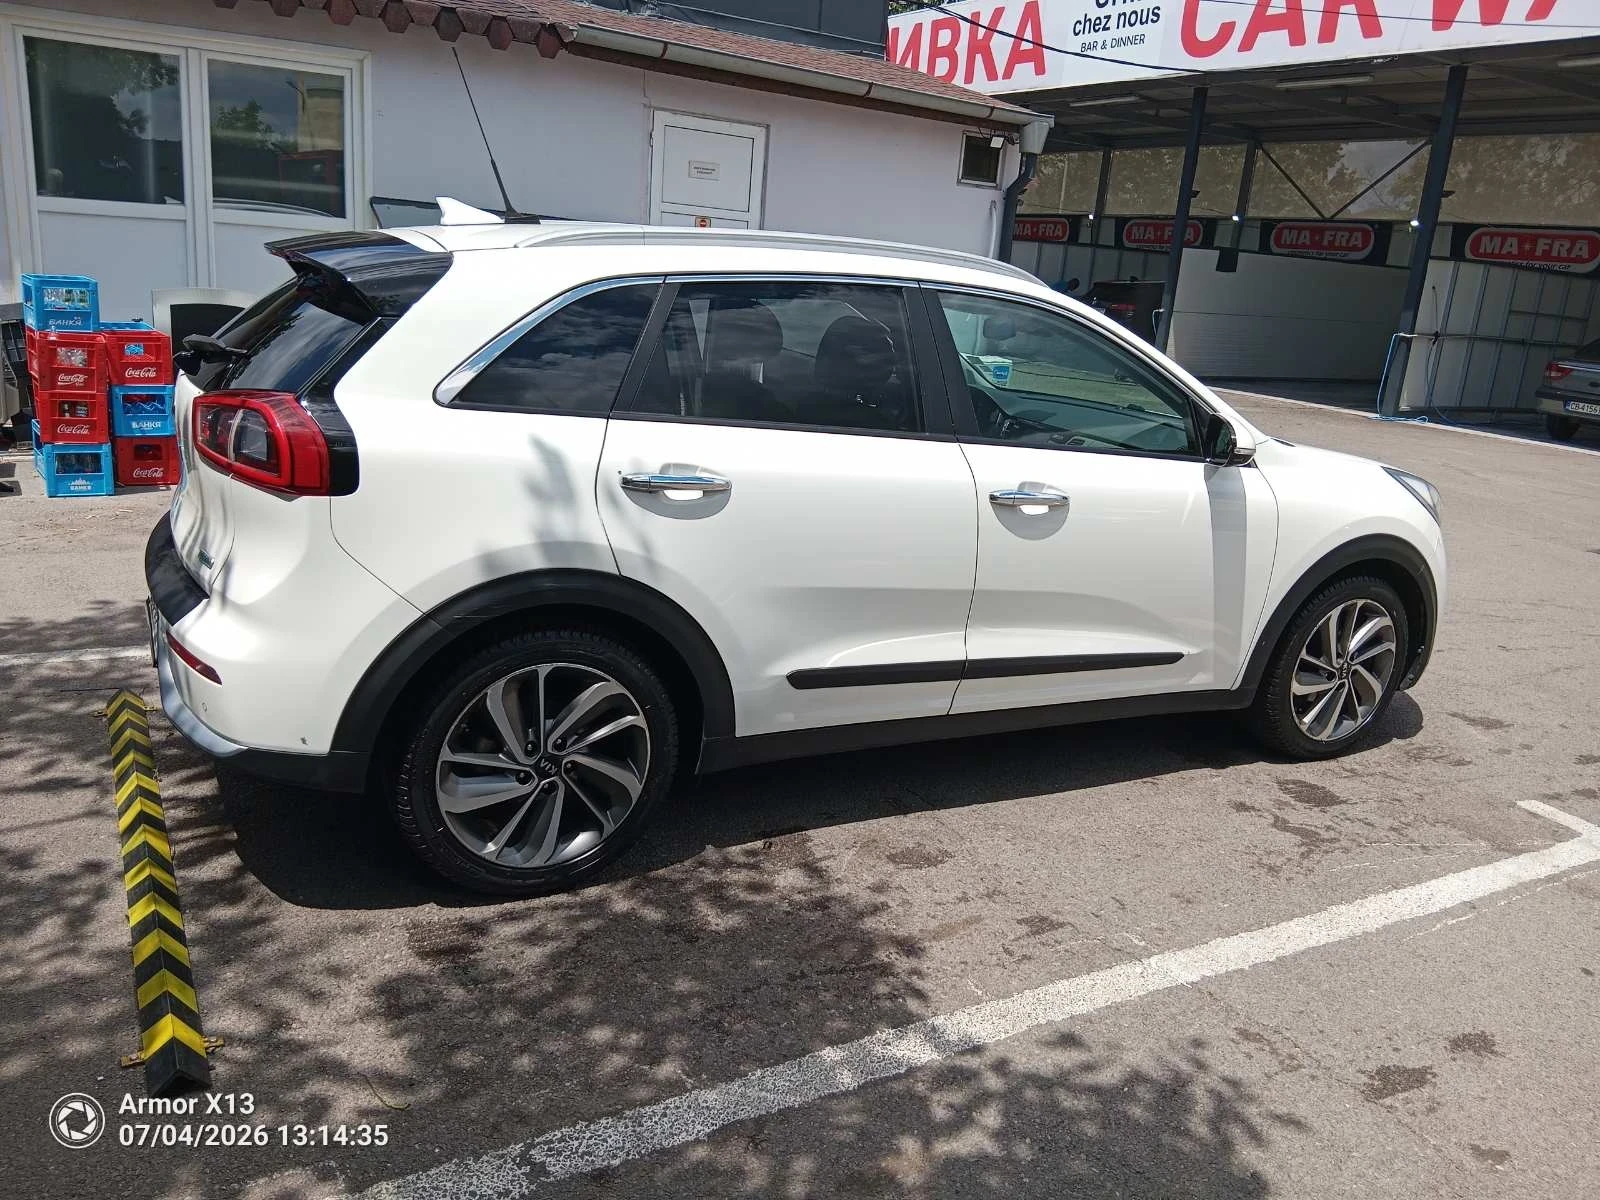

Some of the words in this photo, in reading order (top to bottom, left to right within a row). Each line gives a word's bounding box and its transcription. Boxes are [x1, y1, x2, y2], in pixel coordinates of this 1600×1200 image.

[1073, 13, 1112, 37] chez
[1116, 6, 1161, 30] nous
[1080, 41, 1098, 53] BAR
[1100, 39, 1108, 50] &
[1111, 34, 1146, 49] DINNER
